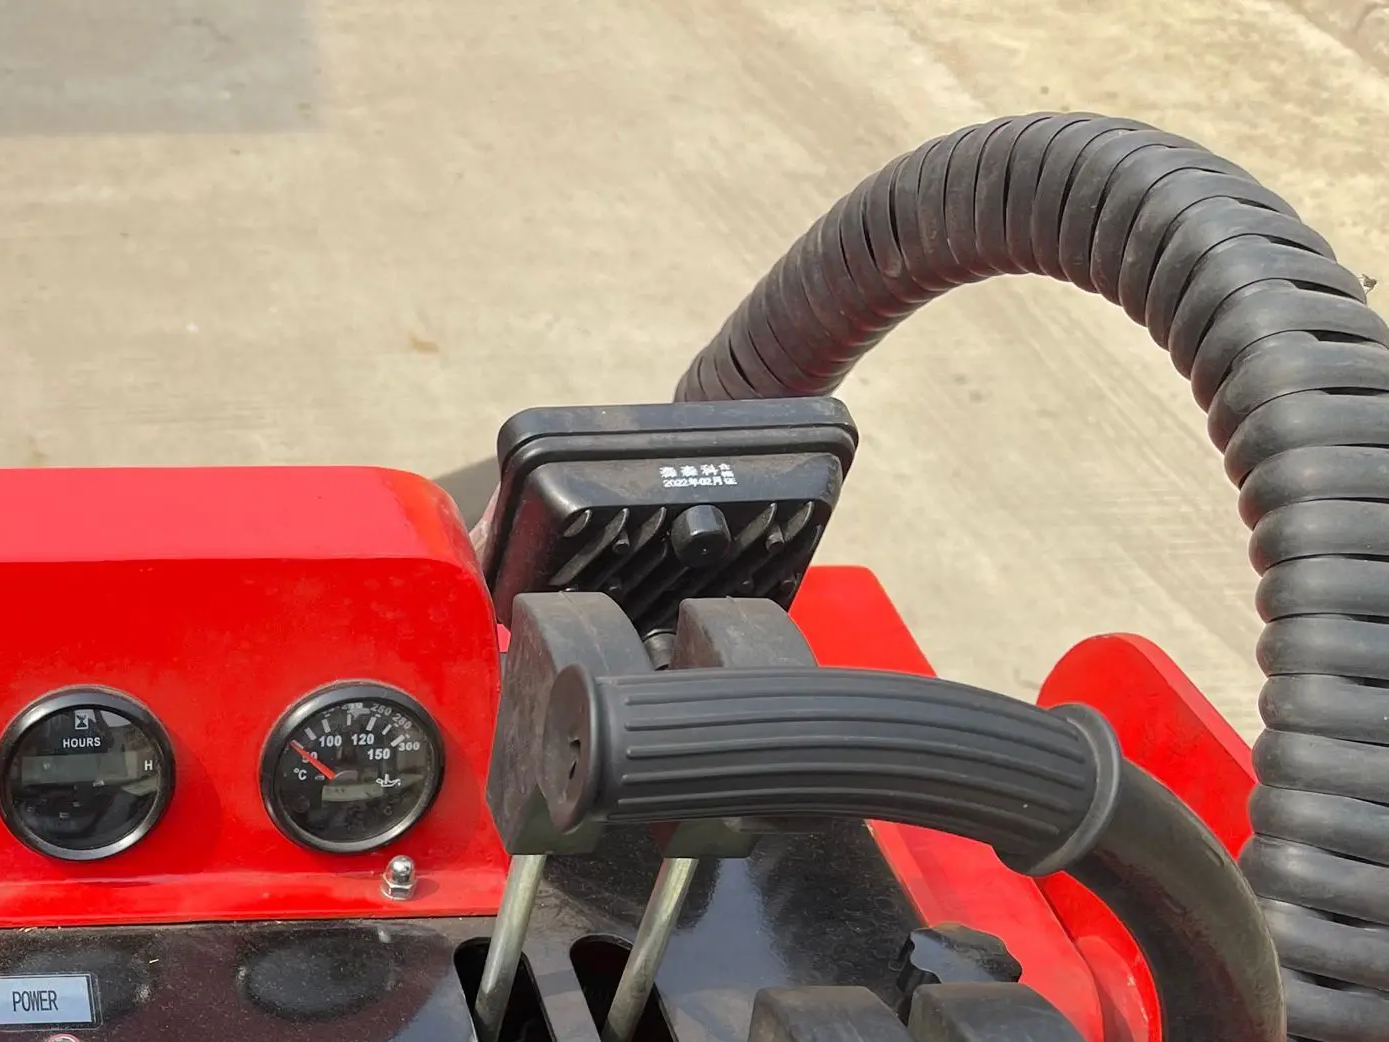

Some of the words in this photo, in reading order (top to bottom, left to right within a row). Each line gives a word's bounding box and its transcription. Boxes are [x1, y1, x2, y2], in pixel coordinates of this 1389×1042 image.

[62, 737, 101, 748] HOURS
[318, 735, 342, 747] 100
[351, 733, 374, 745] 120
[398, 741, 420, 751] 300
[367, 748, 391, 760] 150
[144, 759, 153, 771] H
[12, 990, 58, 1012] POWER
